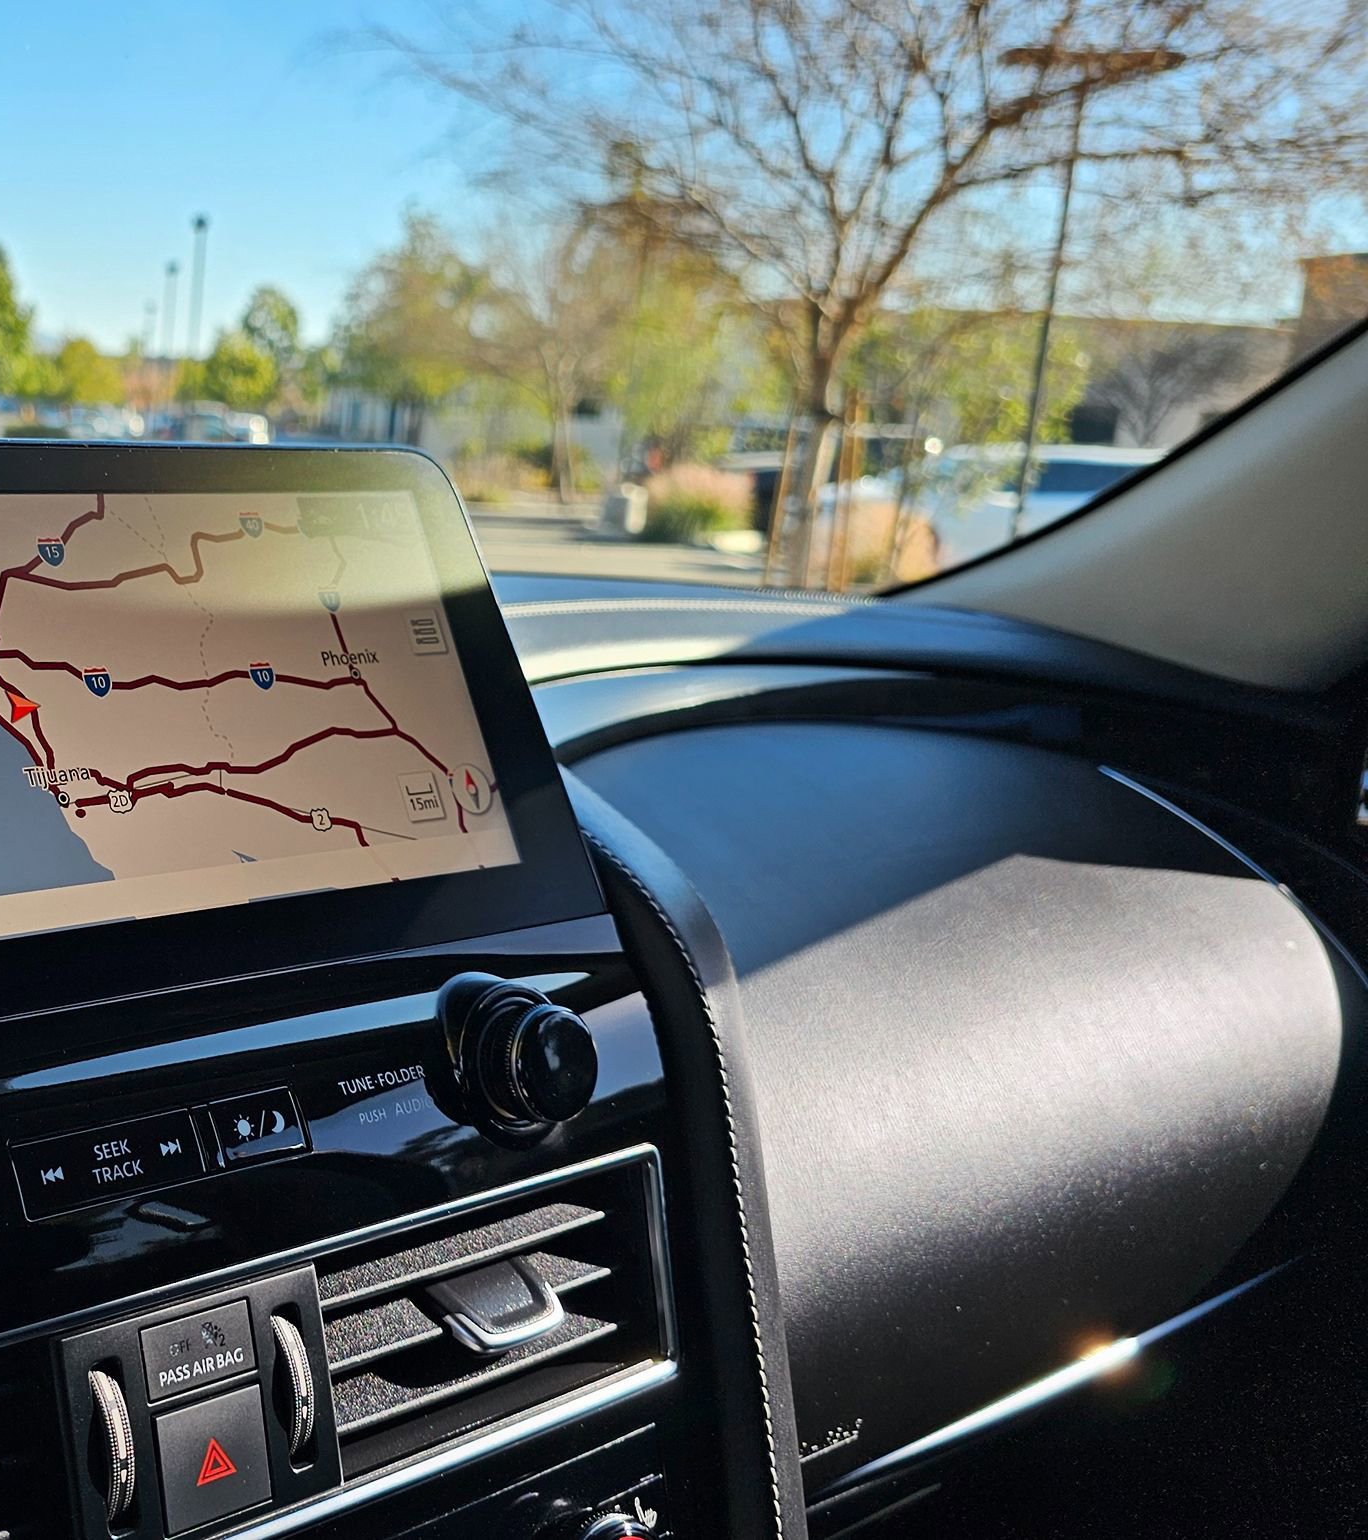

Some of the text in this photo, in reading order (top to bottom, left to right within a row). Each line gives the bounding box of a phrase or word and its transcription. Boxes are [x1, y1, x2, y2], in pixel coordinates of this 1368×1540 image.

[246, 519, 260, 531] 40
[45, 545, 61, 559] 15
[321, 650, 380, 667] Phoenix
[90, 676, 106, 690] 10
[256, 670, 271, 683] 10
[23, 767, 91, 789] Tijuana
[112, 795, 129, 808] 2D
[409, 795, 440, 812] 15mi
[317, 813, 326, 826] 2
[358, 1108, 387, 1125] PUSH
[93, 1138, 132, 1161] SEEK
[92, 1159, 144, 1184] TRACK
[158, 1347, 245, 1387] PASS AIR BAG
